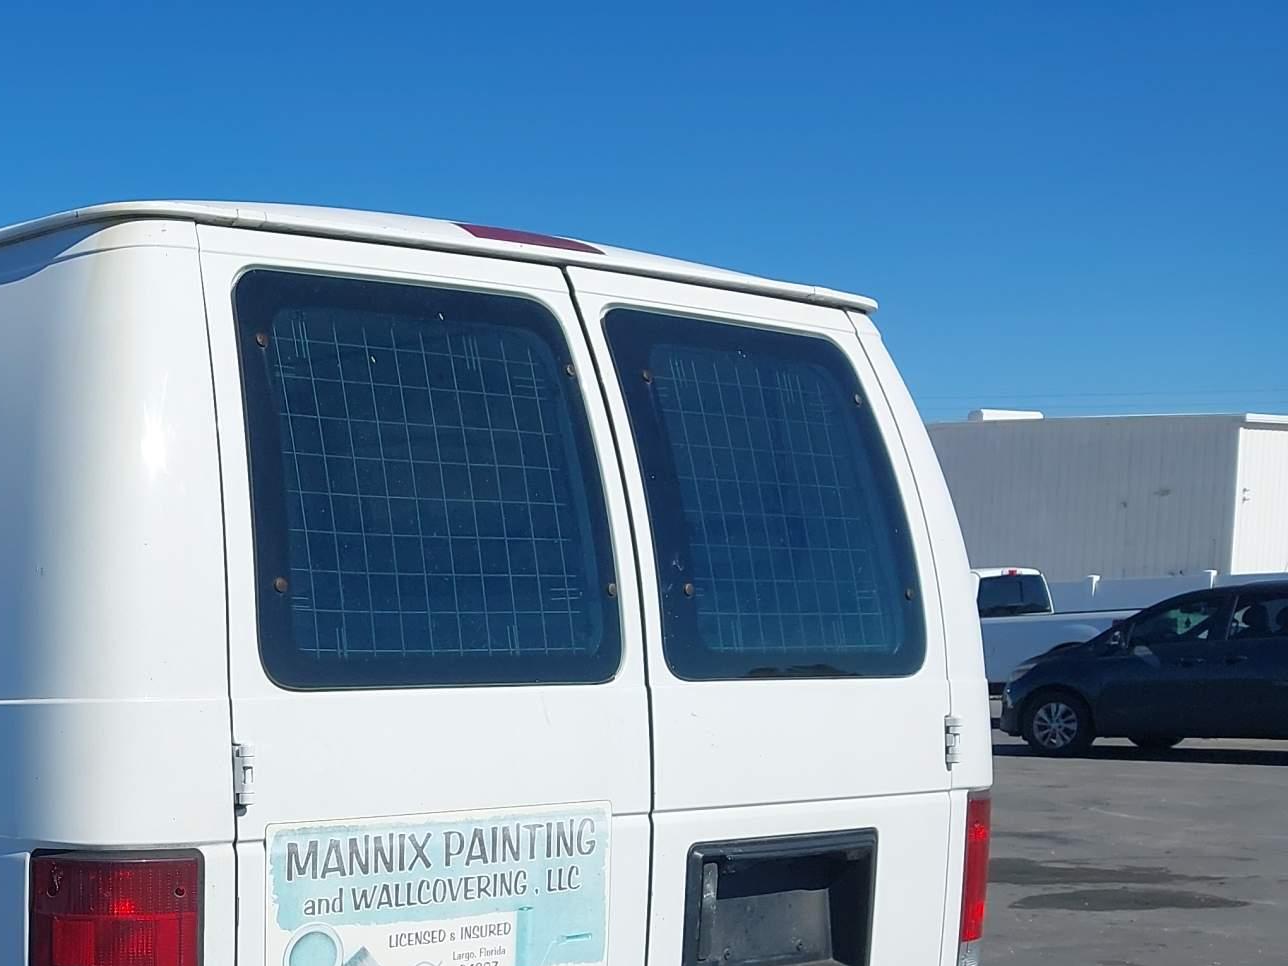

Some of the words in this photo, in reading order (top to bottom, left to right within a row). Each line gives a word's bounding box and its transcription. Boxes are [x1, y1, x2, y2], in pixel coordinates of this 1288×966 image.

[286, 832, 432, 882] MANNIX
[443, 818, 596, 867] PAINTING
[303, 887, 344, 916] and
[547, 866, 581, 892] LLC
[388, 929, 446, 948] LICENSED
[460, 922, 512, 940] INSURED
[452, 951, 477, 961] Largo,
[479, 946, 506, 958] Florida
